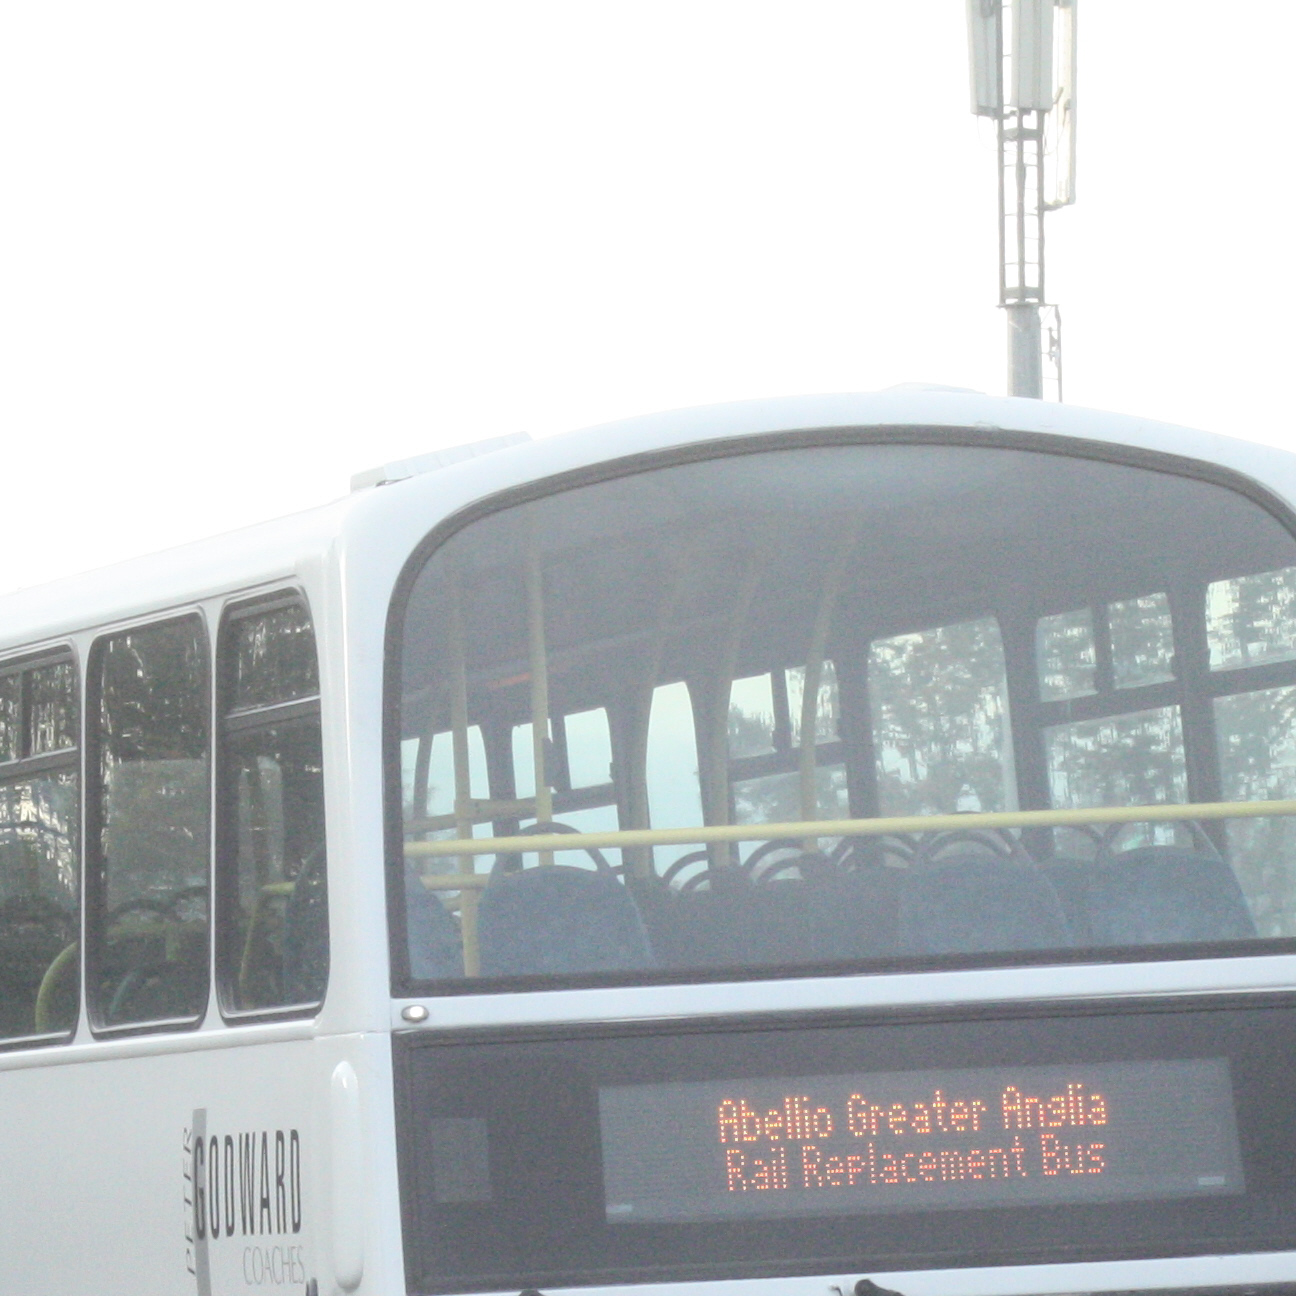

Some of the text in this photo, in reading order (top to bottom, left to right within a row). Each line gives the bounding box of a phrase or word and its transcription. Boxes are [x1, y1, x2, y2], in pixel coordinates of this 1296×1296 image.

[718, 1083, 1107, 1143] Abellio Greater Anglia
[725, 1133, 1106, 1191] Rail Replacement Bus
[243, 1245, 305, 1286] COACHES
